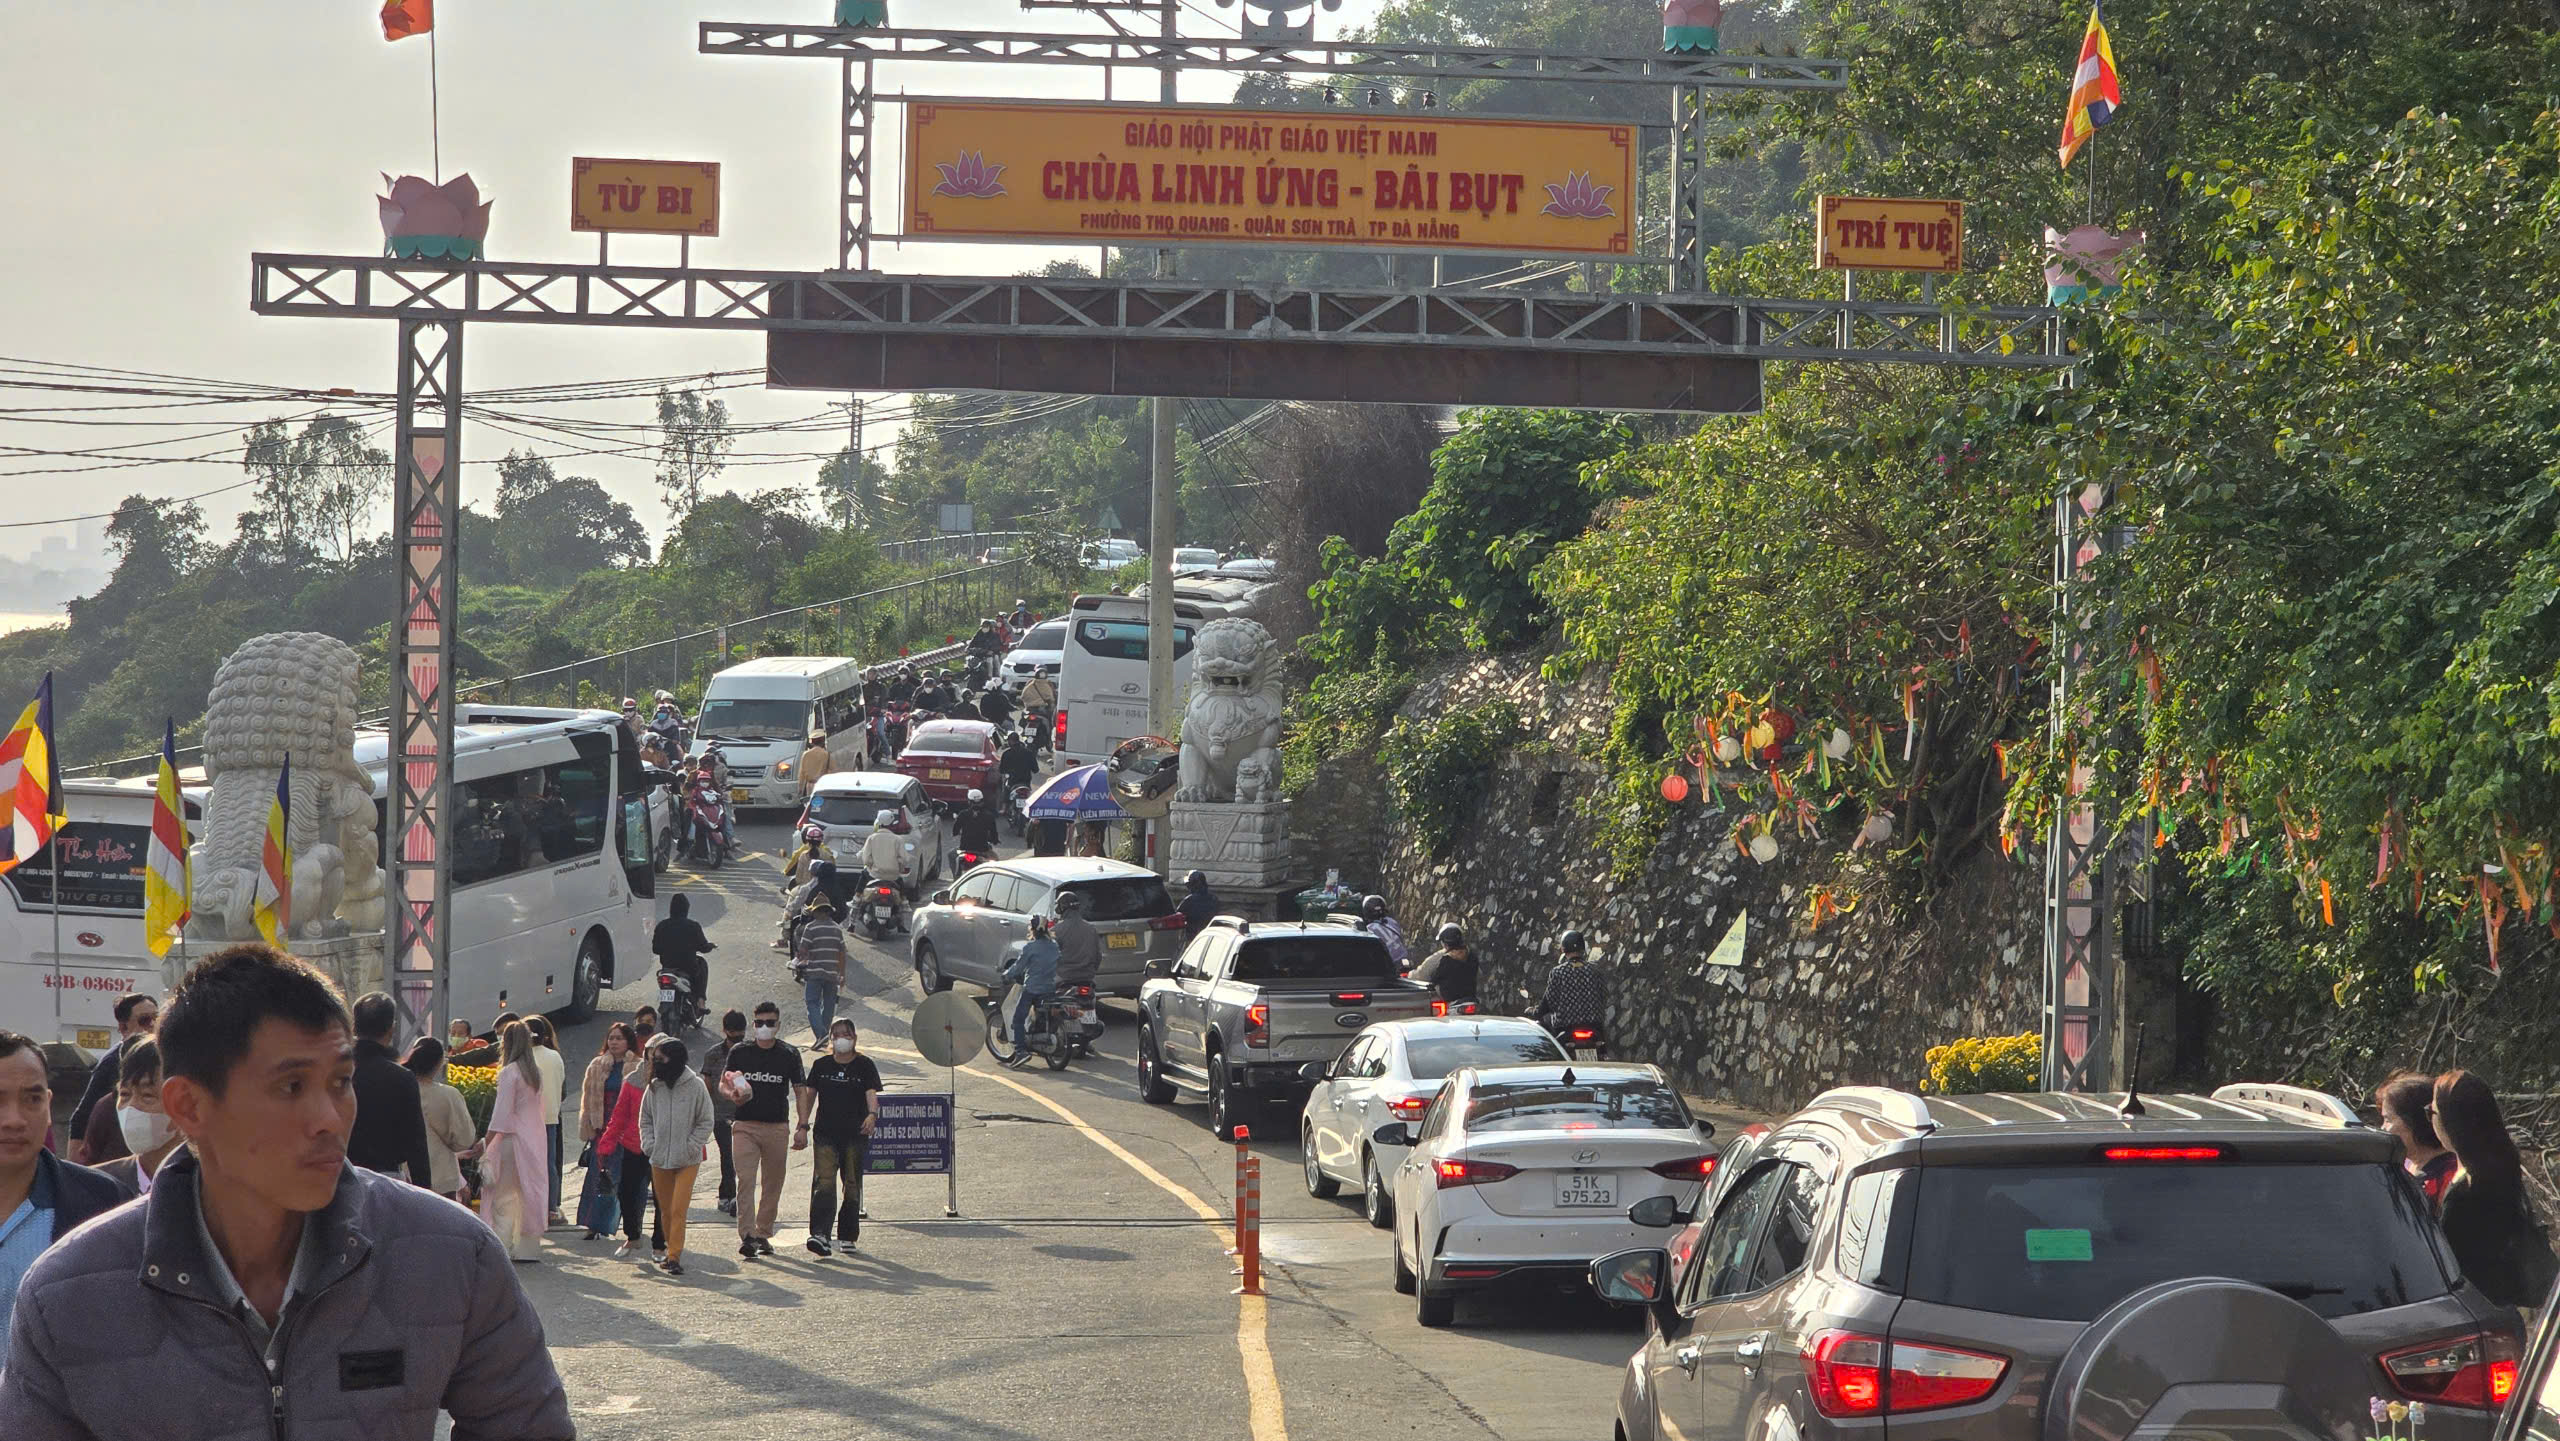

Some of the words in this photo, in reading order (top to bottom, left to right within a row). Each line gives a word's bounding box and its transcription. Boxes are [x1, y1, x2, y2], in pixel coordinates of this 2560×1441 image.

[1125, 118, 1173, 148] GIÁO
[1179, 119, 1213, 155] HỘI
[1220, 121, 1273, 156] PHẬT
[1280, 123, 1329, 153] GIÁO
[1336, 124, 1381, 159] VIỆT
[1388, 130, 1437, 156] NAM
[1043, 152, 1141, 201] CHÙA
[1152, 163, 1245, 205] LINH
[1256, 157, 1339, 208] ỨNG
[1350, 186, 1363, 195] -
[1374, 163, 1439, 211] BÃI
[1450, 172, 1524, 221] BỤT
[598, 177, 646, 213] TỪ
[657, 186, 693, 215] BI
[1080, 209, 1141, 230] PHƯỜNG
[1146, 215, 1174, 235] THỌ
[1178, 215, 1230, 233] QUANG
[1291, 218, 1322, 235] SƠN
[1327, 217, 1356, 236] TRÀ
[1368, 221, 1387, 236] TP
[1392, 218, 1412, 238] ĐÀ
[1837, 214, 1887, 249] TRÍ
[1894, 217, 1953, 256] TUỆ
[1085, 792, 1111, 800] NEW
[41, 891, 137, 903] UNIVERSE
[83, 976, 136, 992] 03697
[743, 1071, 783, 1083] adidas
[882, 1103, 904, 1118] KHÁCH
[905, 1103, 926, 1118] THÔNG
[897, 1127, 906, 1138] 52
[921, 1124, 935, 1139] QUÁ
[1573, 1176, 1599, 1189] 51K
[1562, 1190, 1610, 1204] 975.23
